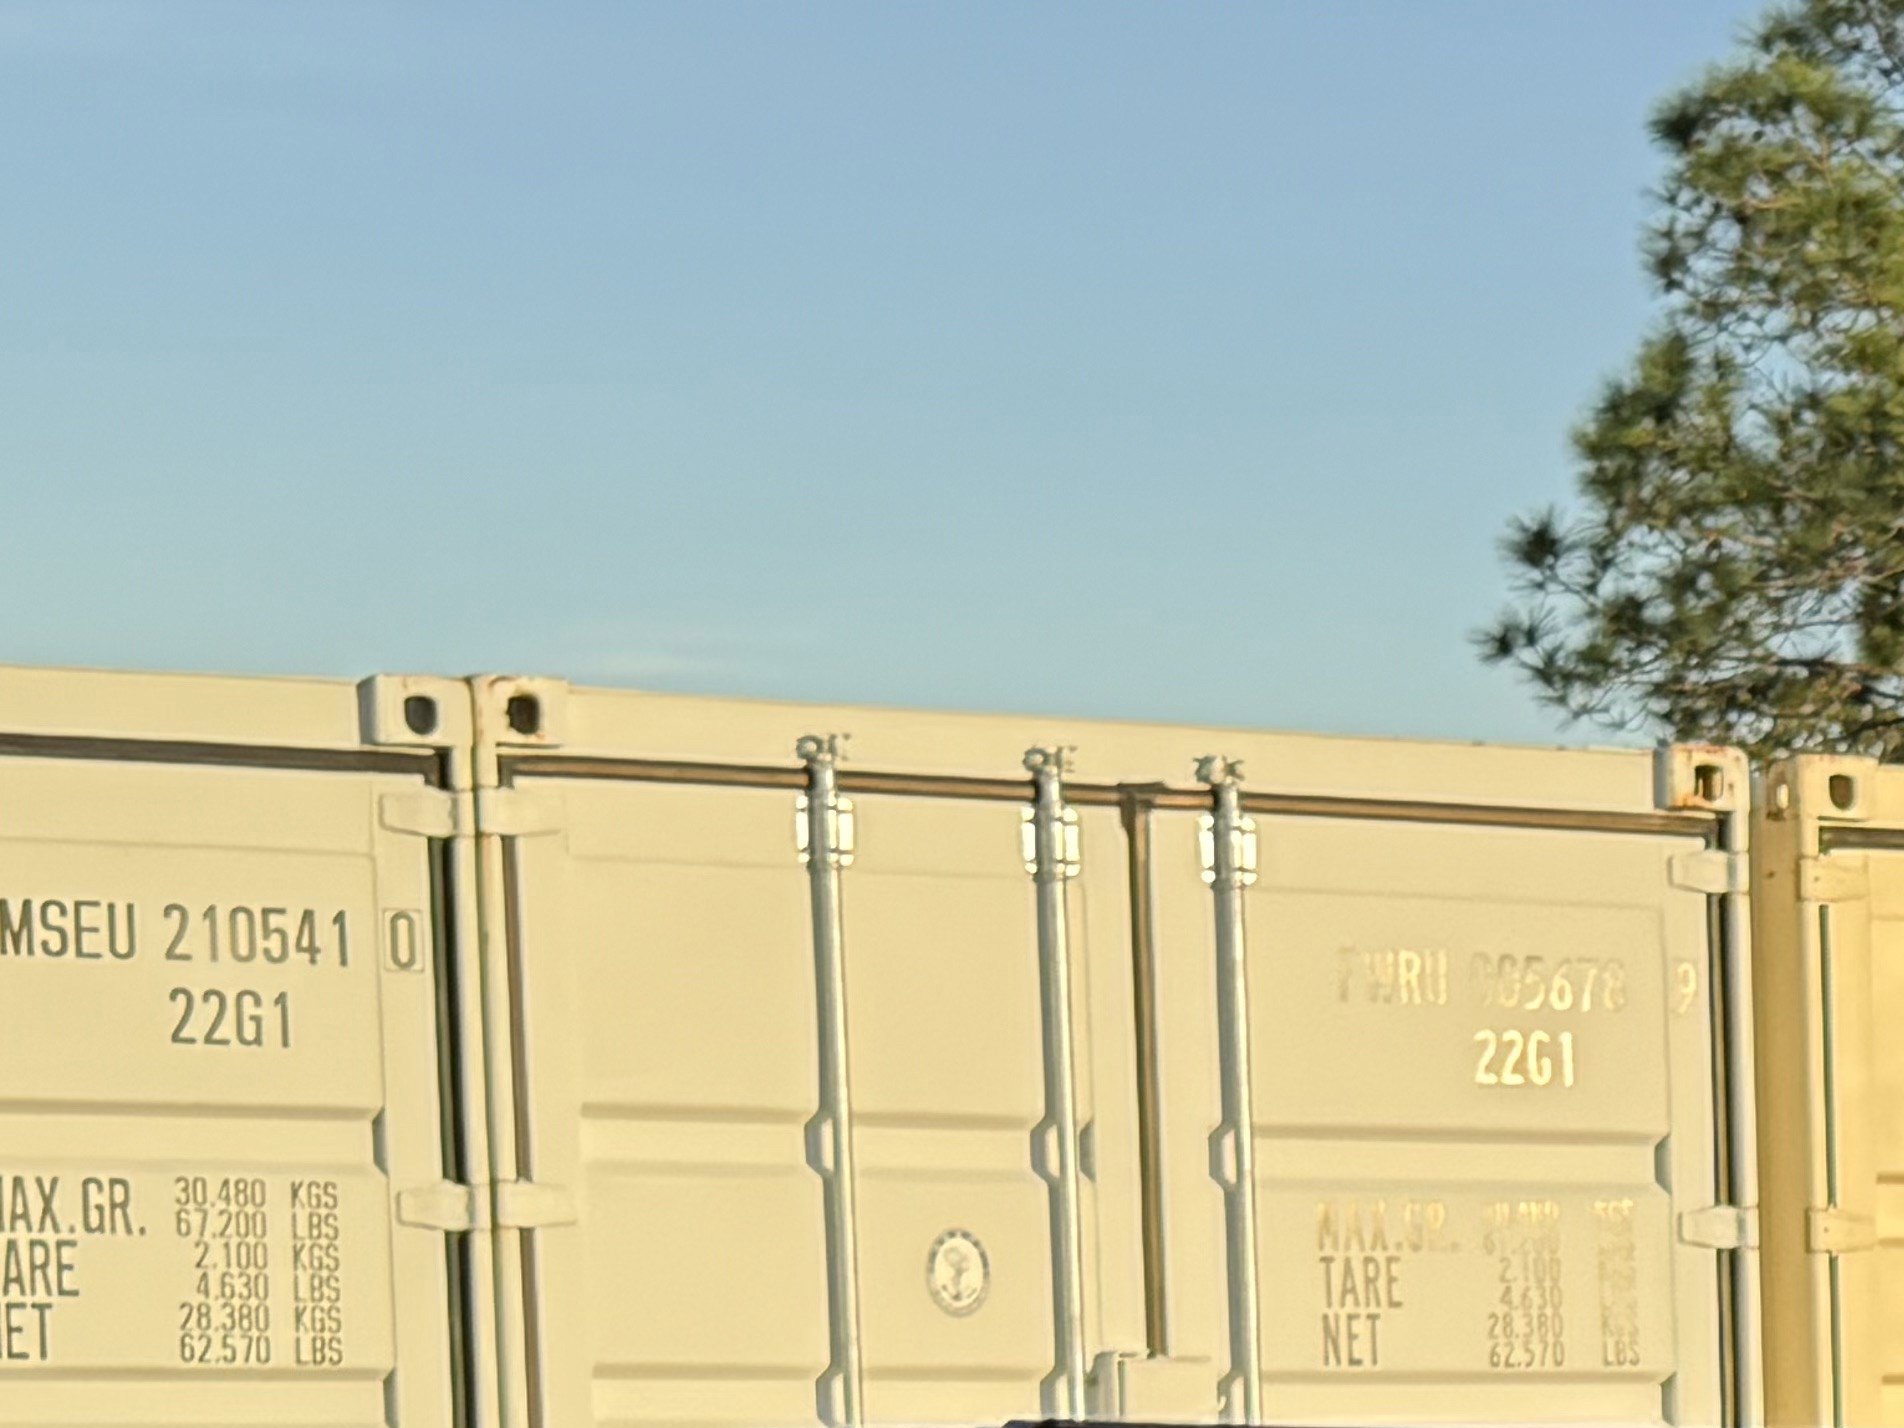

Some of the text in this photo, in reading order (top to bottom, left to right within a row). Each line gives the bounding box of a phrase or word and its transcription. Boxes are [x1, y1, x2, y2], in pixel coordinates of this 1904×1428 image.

[0, 899, 416, 969] MSEU 210541 0
[168, 986, 291, 1048] 22G1
[1473, 1029, 1575, 1087] 22G1
[0, 1175, 338, 1236] AX.GR. 30.480 KGS
[175, 1208, 339, 1241] 67.200 LBS
[2, 1239, 340, 1297] ARE 2.100 KGS
[196, 1271, 341, 1303] 4.630 LBS
[1319, 1256, 1403, 1308] TARE
[0, 1301, 342, 1360] ET 28.380 KGS
[179, 1332, 343, 1366] 62.570 LBS
[1322, 1313, 1381, 1367] NET
[1603, 1340, 1640, 1367] LBS
